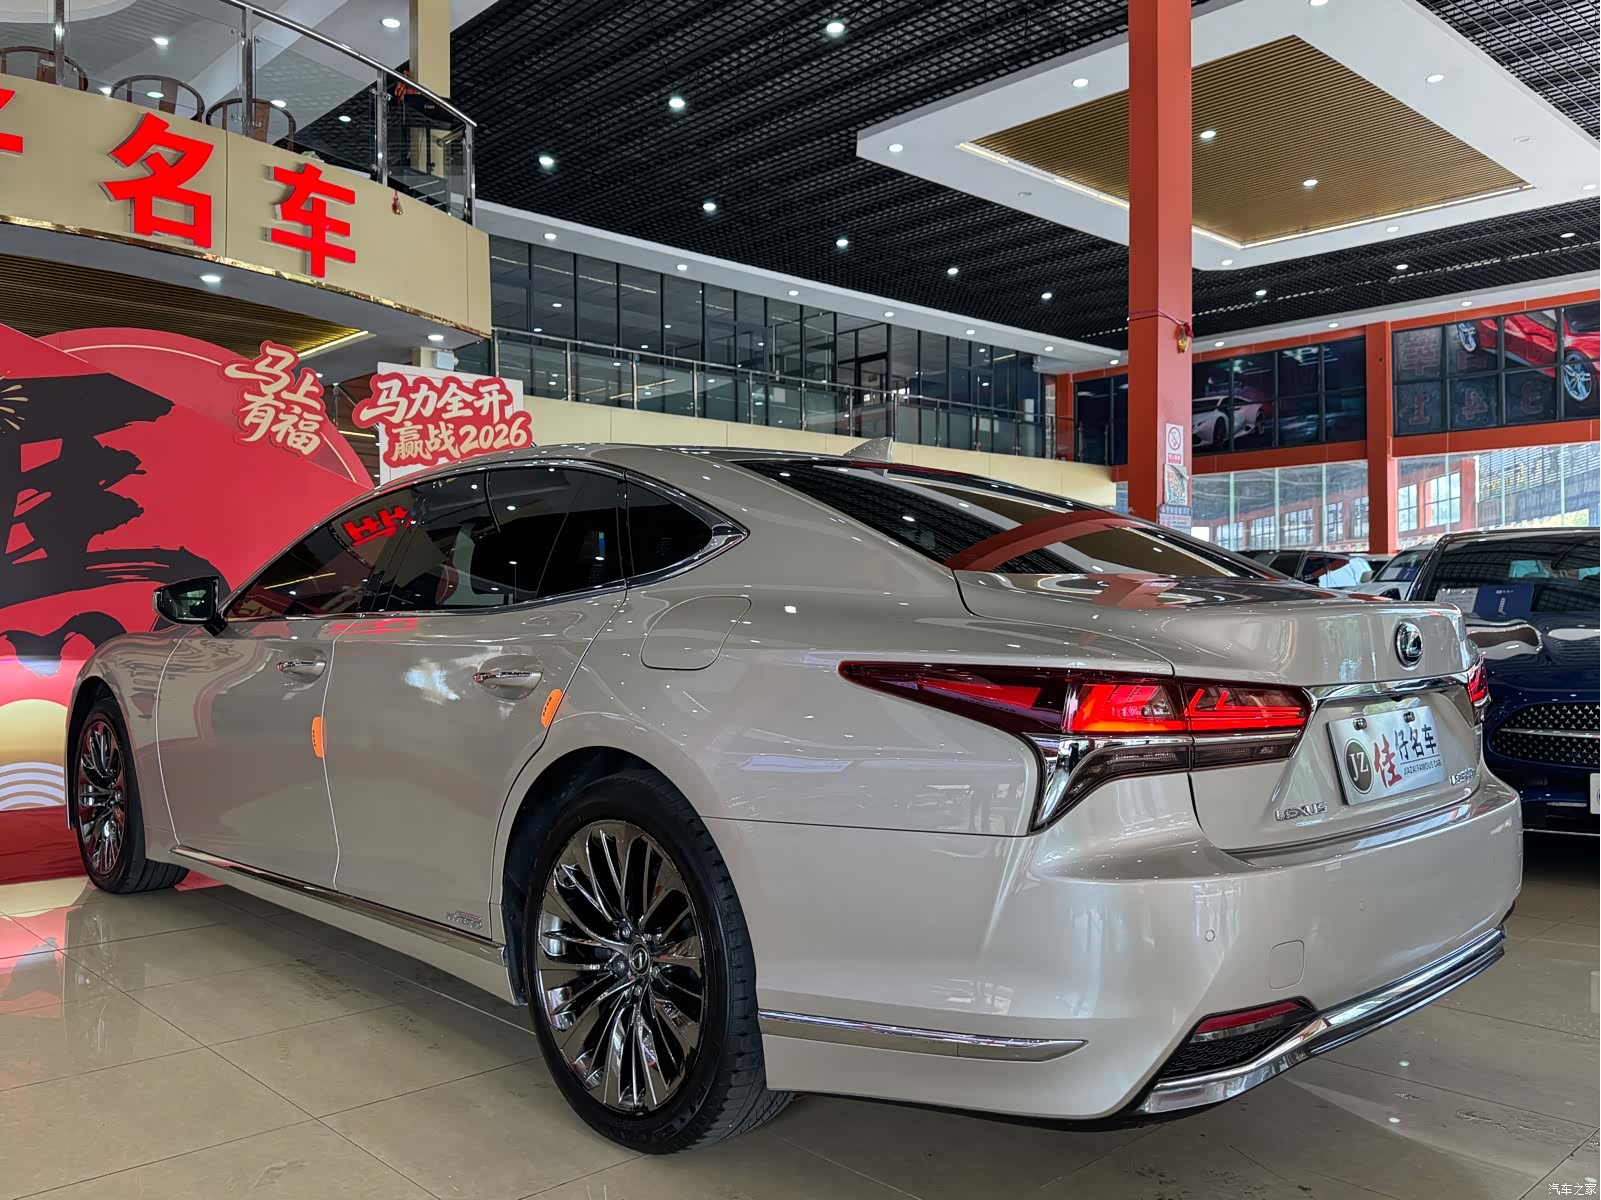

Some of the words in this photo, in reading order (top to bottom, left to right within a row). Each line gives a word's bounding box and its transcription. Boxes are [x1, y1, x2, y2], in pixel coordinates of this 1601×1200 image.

[0, 88, 356, 278] 名车
[360, 378, 508, 424] 马力全开
[390, 416, 529, 462] 赢战2026
[1349, 752, 1369, 781] JZ
[1374, 724, 1437, 788] 佳仔名车
[1275, 802, 1328, 821] LEXUS
